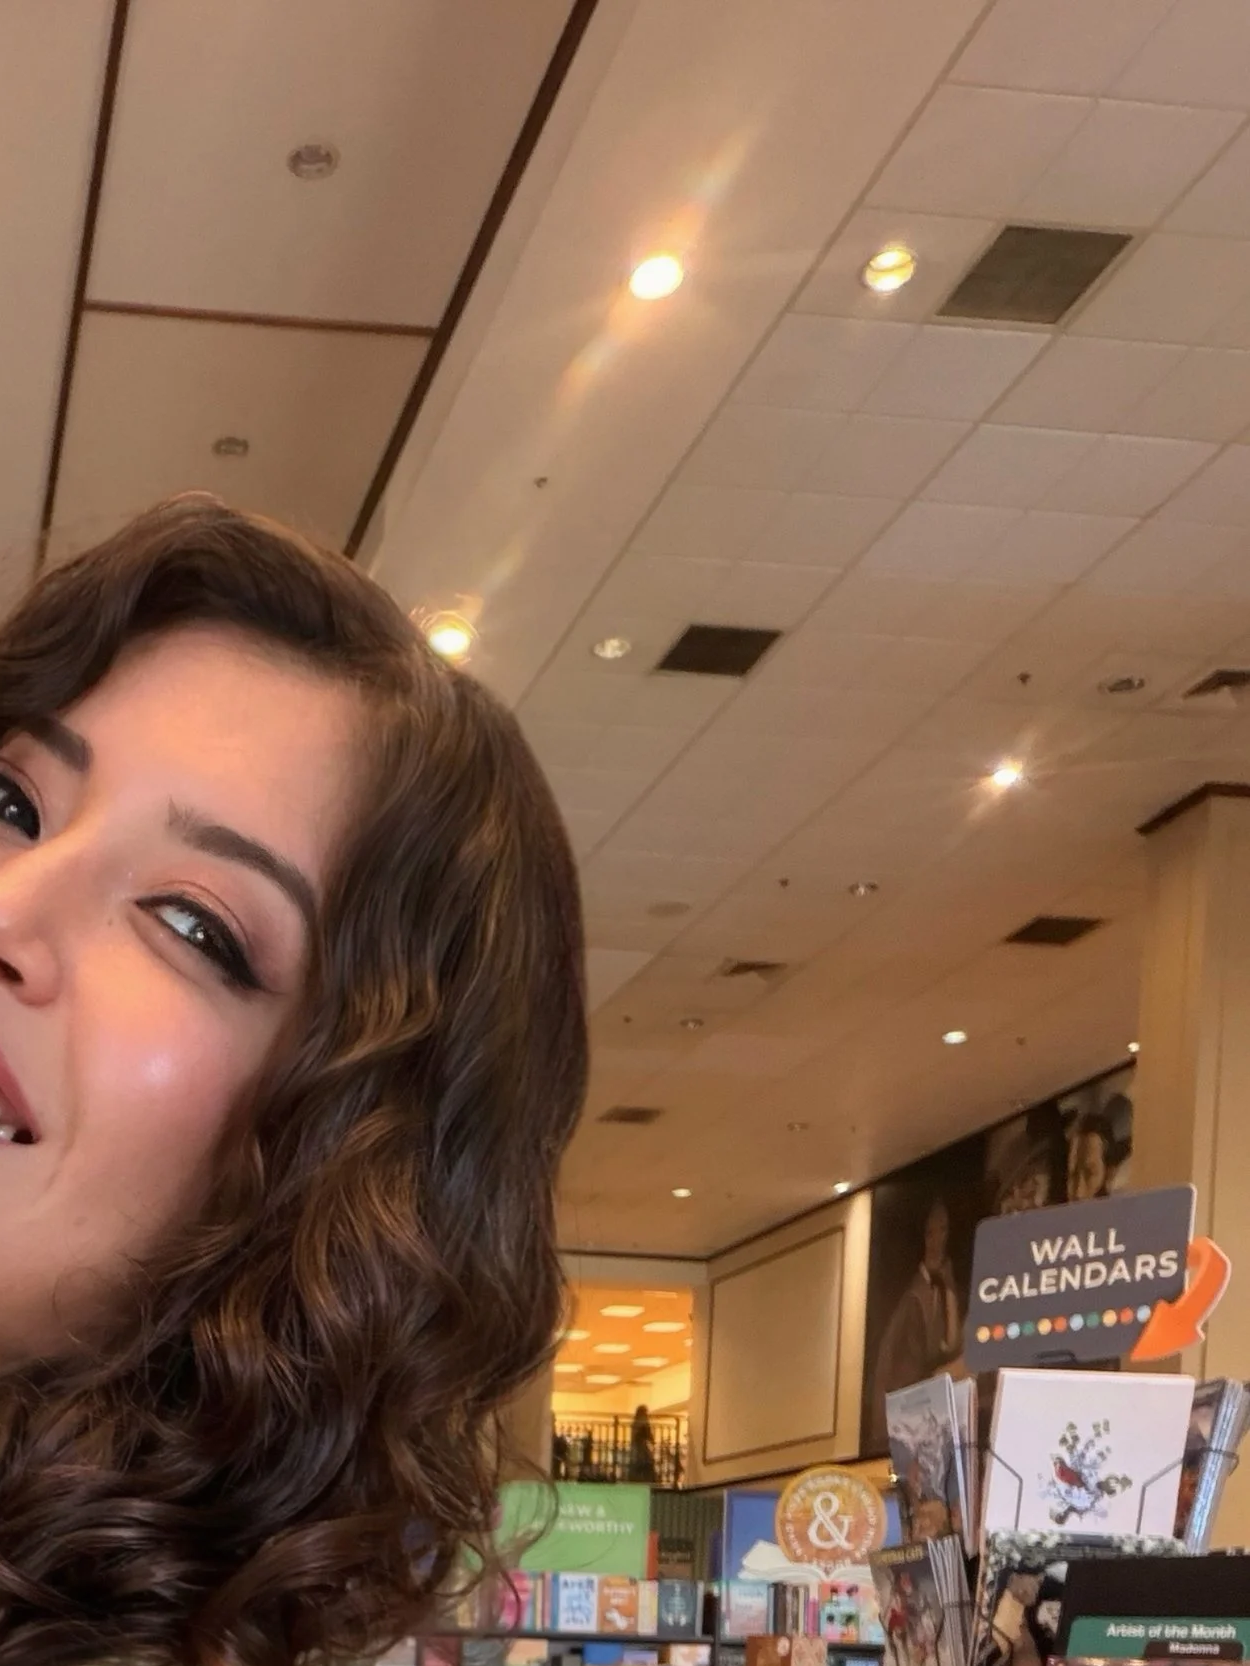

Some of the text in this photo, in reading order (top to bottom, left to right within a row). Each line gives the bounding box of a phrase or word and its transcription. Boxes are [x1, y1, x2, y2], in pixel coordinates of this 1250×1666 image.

[1030, 1228, 1126, 1266] WALL
[978, 1250, 1179, 1304] CALENDARS
[1106, 1623, 1236, 1639] Artist of the Month
[1168, 1641, 1220, 1655] Madonna
